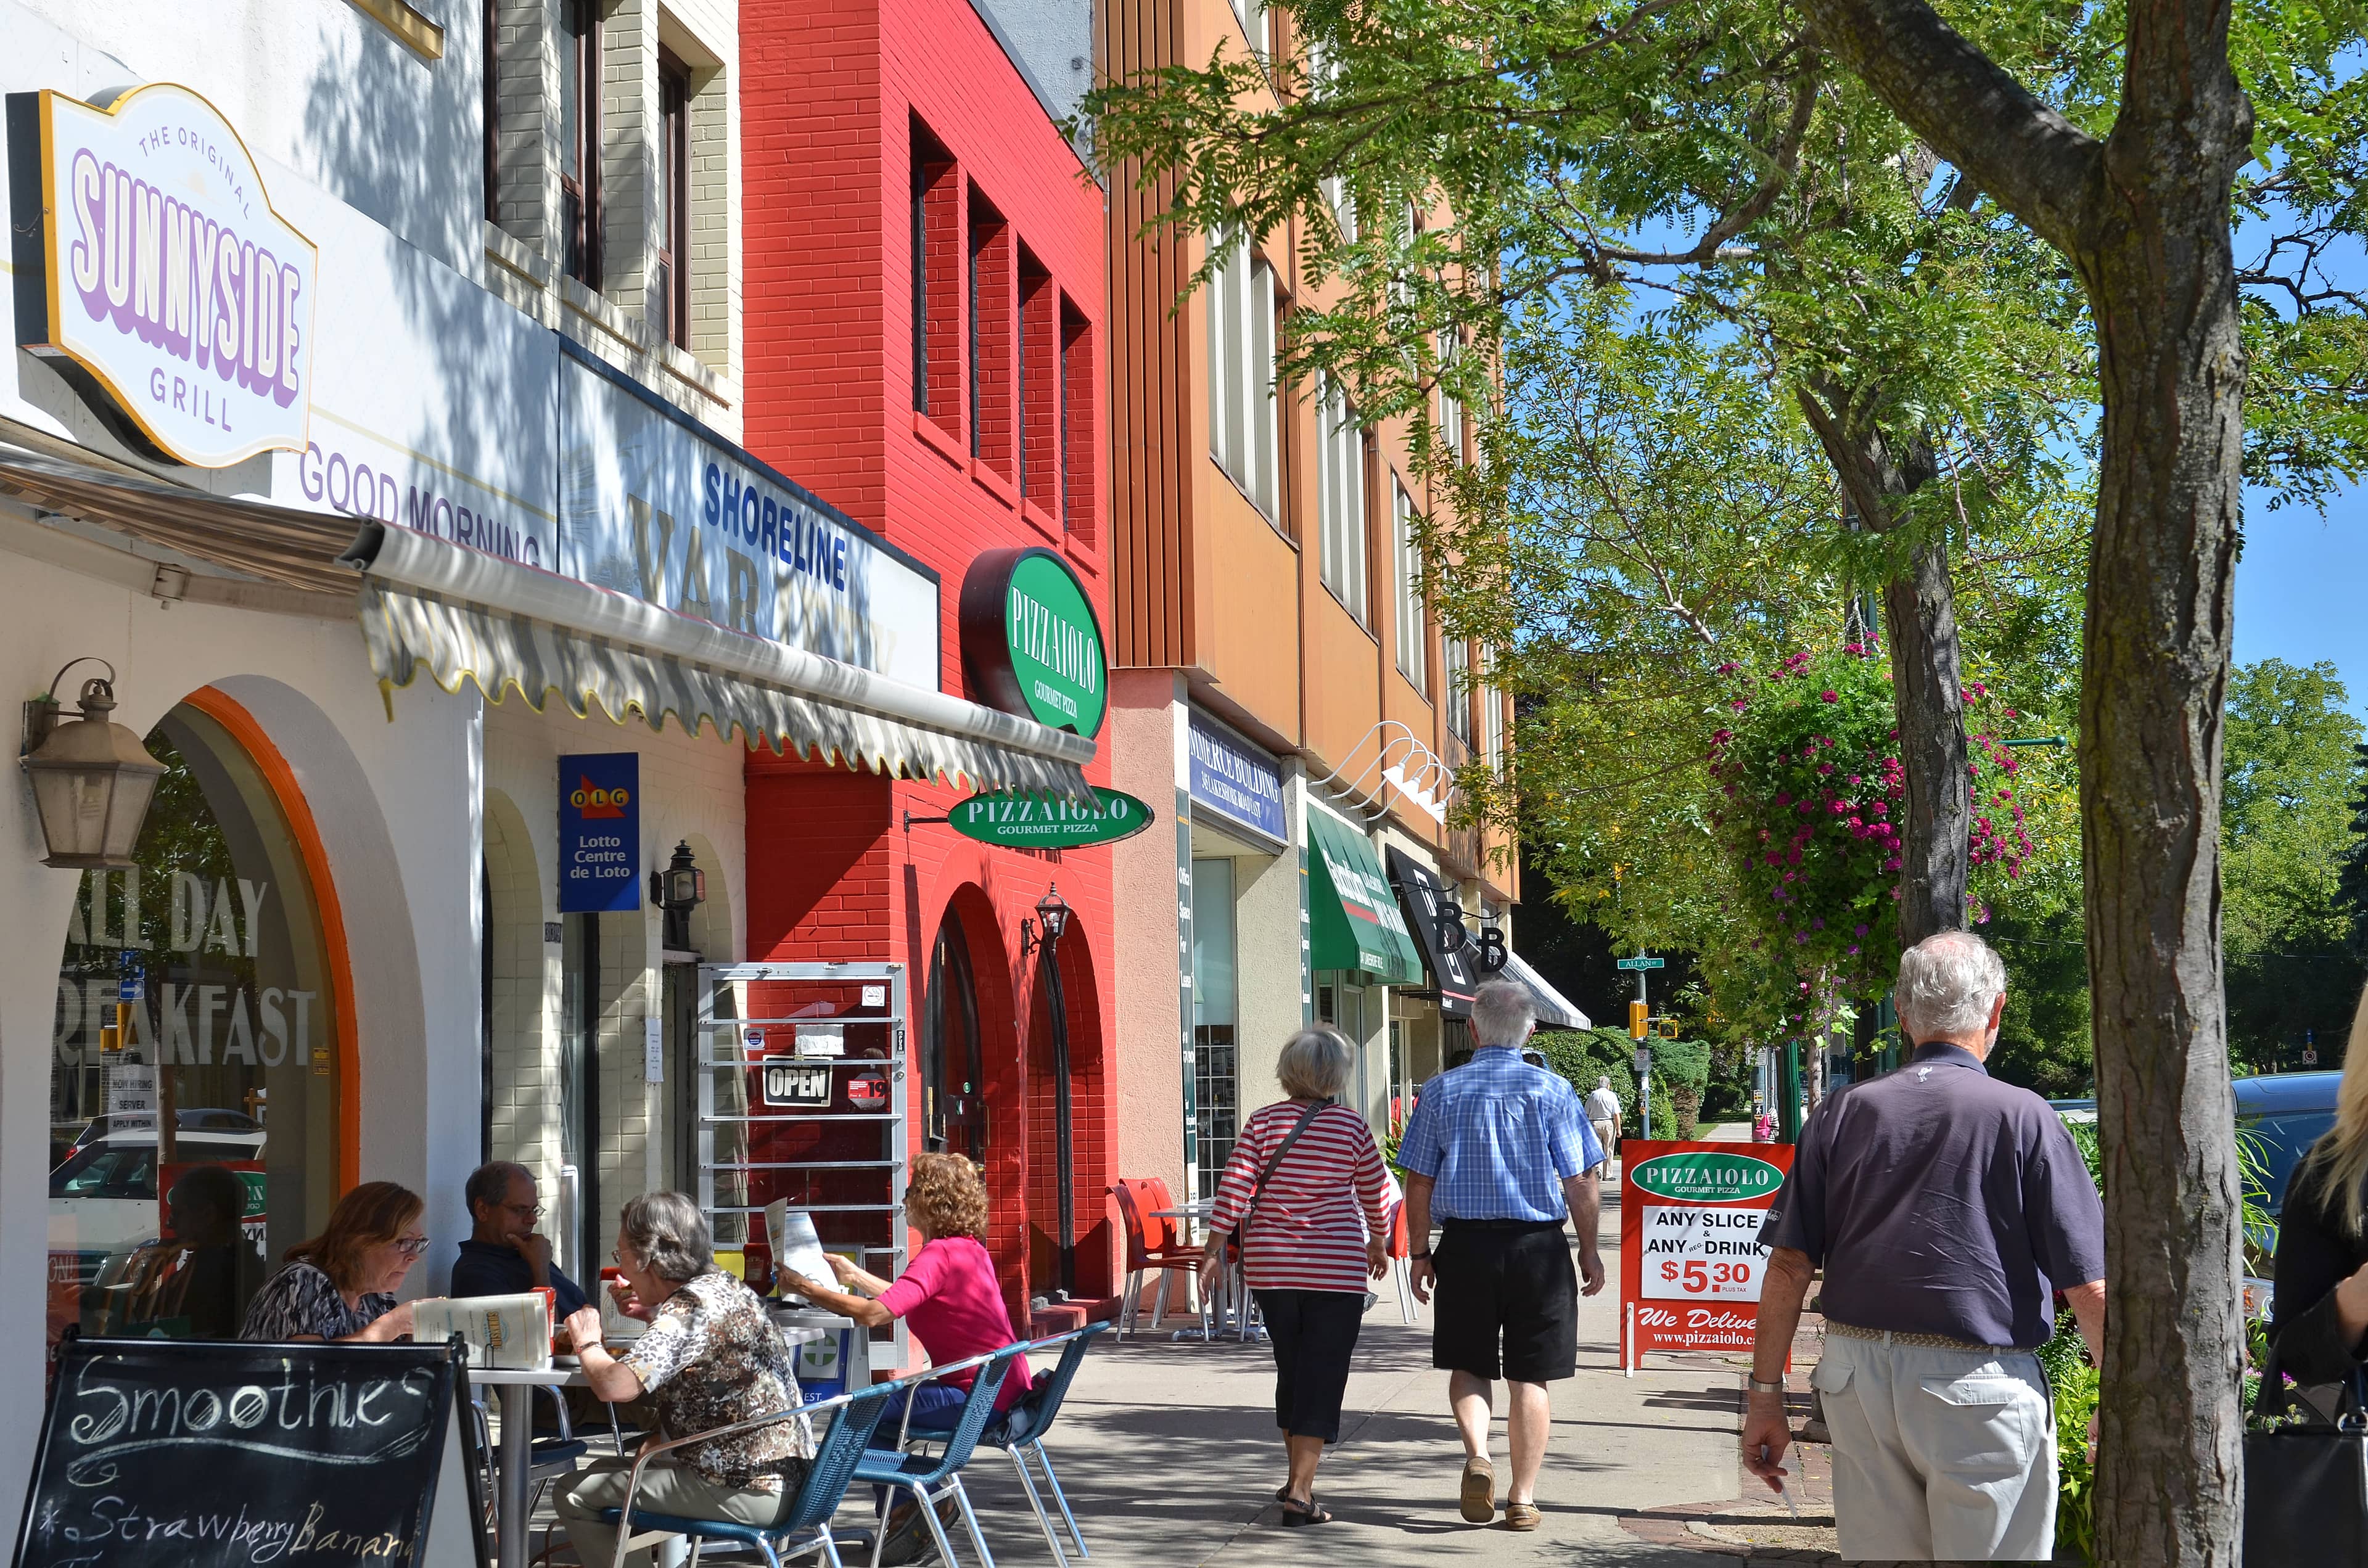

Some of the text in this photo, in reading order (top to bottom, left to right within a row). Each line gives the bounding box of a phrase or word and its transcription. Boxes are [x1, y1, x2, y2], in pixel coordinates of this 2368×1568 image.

[139, 126, 249, 220] THE ORIGINAL
[71, 147, 300, 409] SUNNYSIDE
[150, 367, 232, 433] GRILL
[300, 441, 540, 567] GOOD MORNING
[704, 462, 846, 593] SHORELINE
[1013, 586, 1096, 694] PIZZAIOLO
[1035, 679, 1077, 718] GOURMET PIZZA
[1233, 748, 1278, 803] BUILDING
[572, 789, 626, 807] OLG
[1209, 776, 1238, 807] LAKESHORE
[997, 824, 1098, 835] GOURMET PIZZA
[579, 836, 621, 848] Lotto
[574, 850, 626, 863] Centre
[570, 866, 630, 879] de Loto
[1178, 866, 1190, 887] Office
[170, 871, 268, 958] DAY
[1179, 901, 1191, 923] Space
[113, 1079, 153, 1089] NOW HIRING
[770, 1068, 826, 1097] OPEN
[868, 1081, 886, 1098] 19
[119, 1101, 146, 1109] SERVER
[112, 1119, 152, 1128] APPLY WITHIN
[1646, 1168, 1769, 1186] PIZZAIOLO
[1717, 1186, 1741, 1194] PIZZA
[1656, 1212, 1758, 1229] ANY SLICE
[1648, 1239, 1765, 1256] ANY REG. DRINK
[1661, 1260, 1751, 1294] $5.30
[1638, 1307, 1678, 1327] We
[804, 1392, 823, 1402] EST.
[65, 1495, 294, 1564] Strawberry
